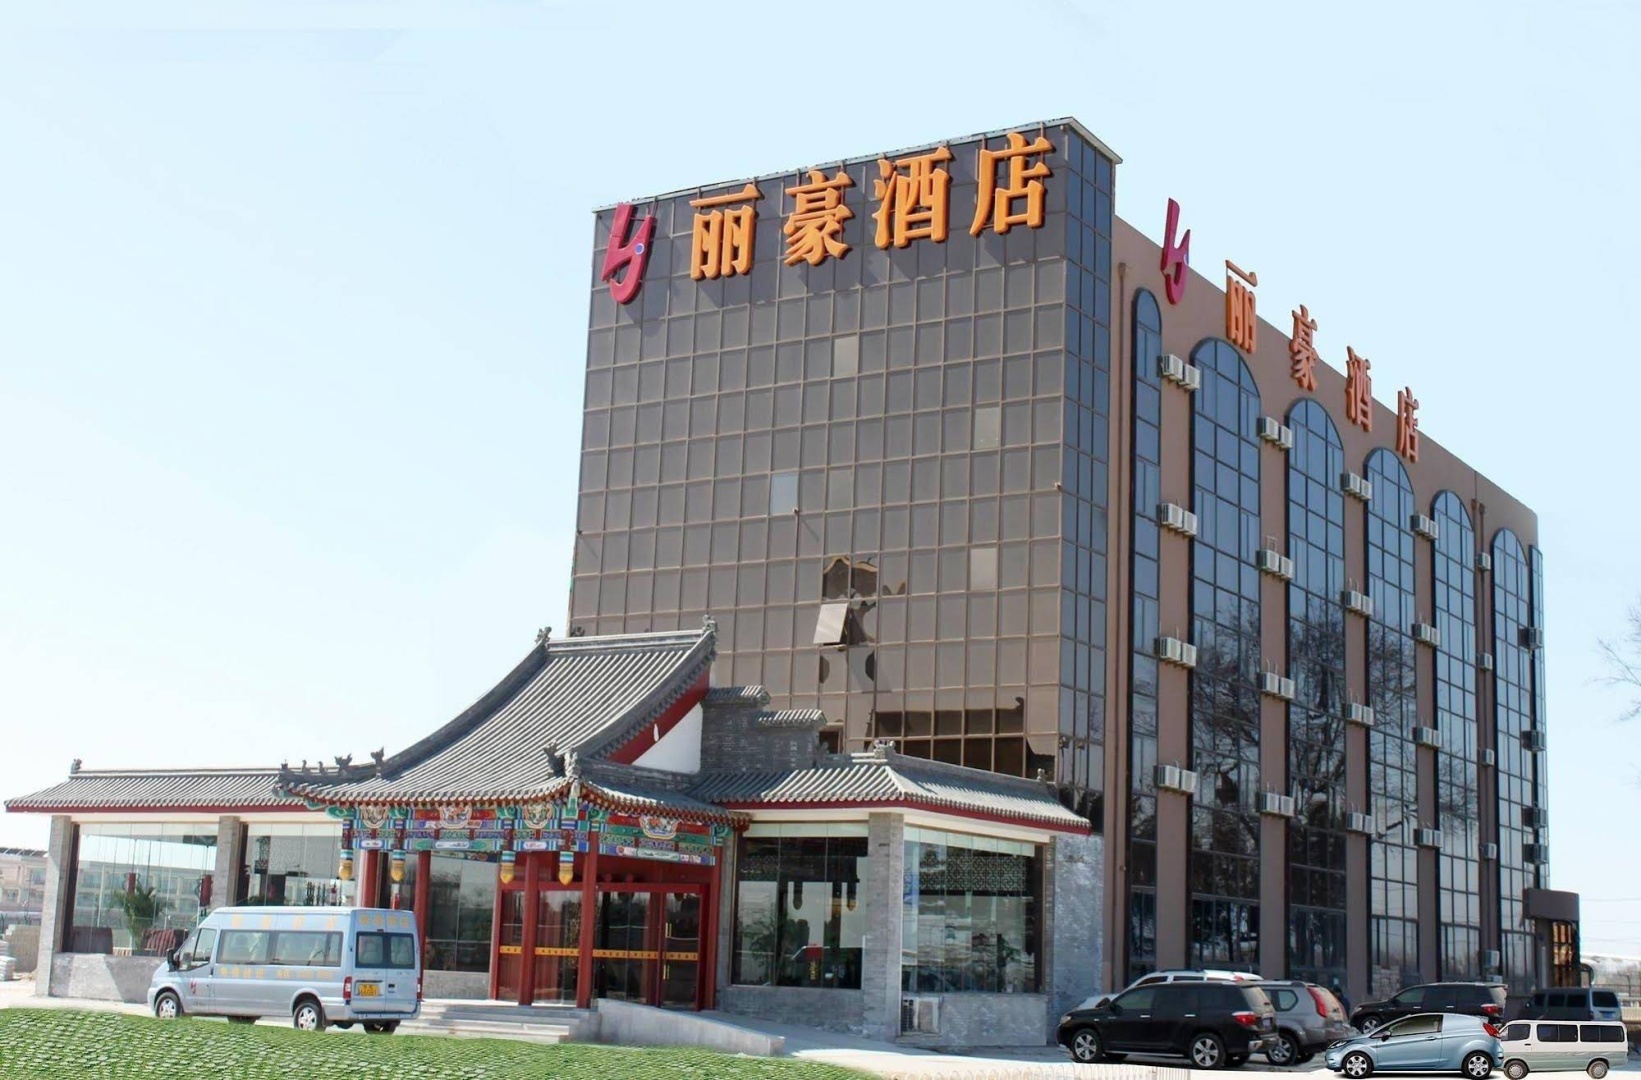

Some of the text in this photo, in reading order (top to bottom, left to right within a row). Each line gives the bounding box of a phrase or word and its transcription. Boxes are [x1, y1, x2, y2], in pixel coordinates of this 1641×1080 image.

[689, 132, 1054, 280] 丽豪酒店
[1225, 260, 1419, 463] 丽豪酒店
